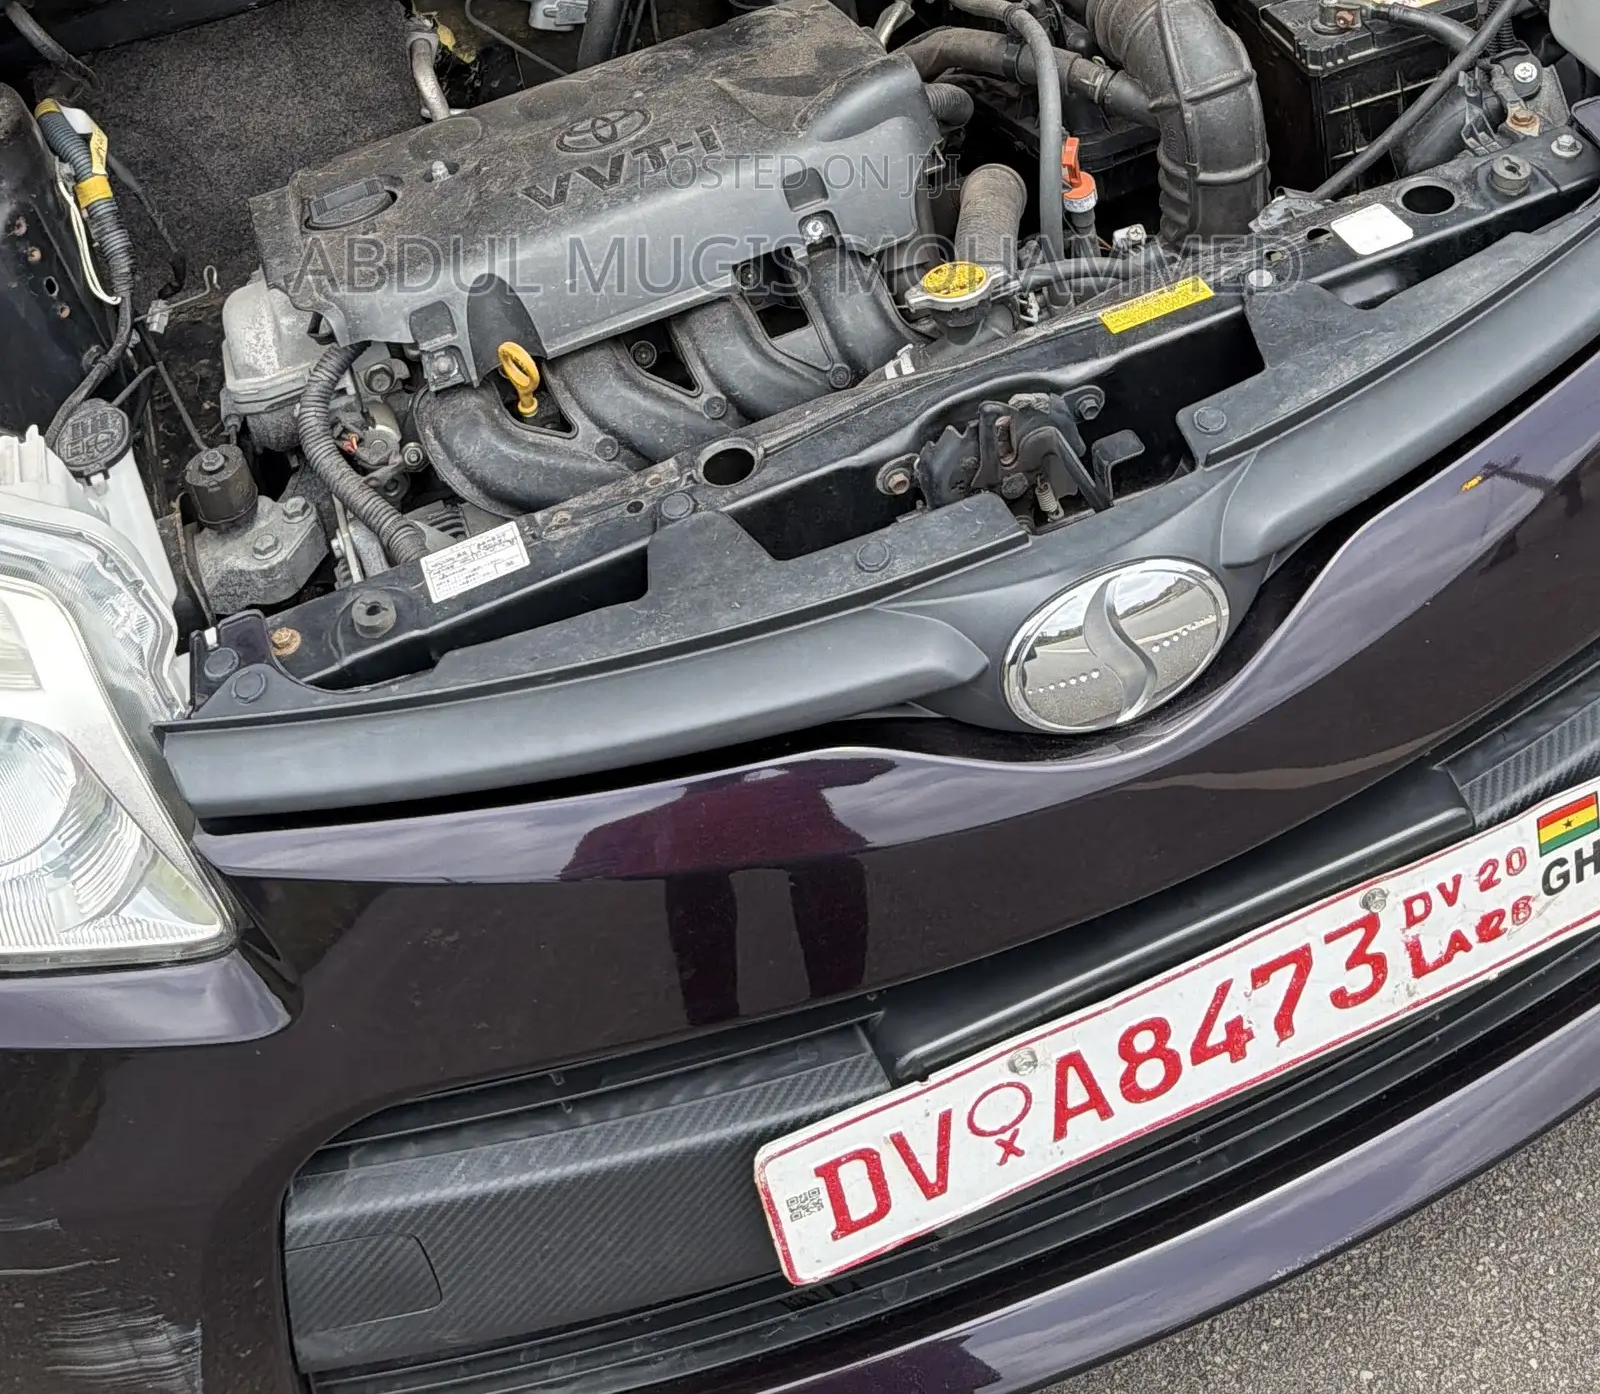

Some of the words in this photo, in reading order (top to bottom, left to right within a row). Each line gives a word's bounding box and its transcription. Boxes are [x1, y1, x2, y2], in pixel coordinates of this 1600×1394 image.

[1403, 873, 1462, 929] DV
[1476, 846, 1527, 893] 20
[814, 1108, 952, 1242] DV
[1051, 912, 1389, 1142] A8473
